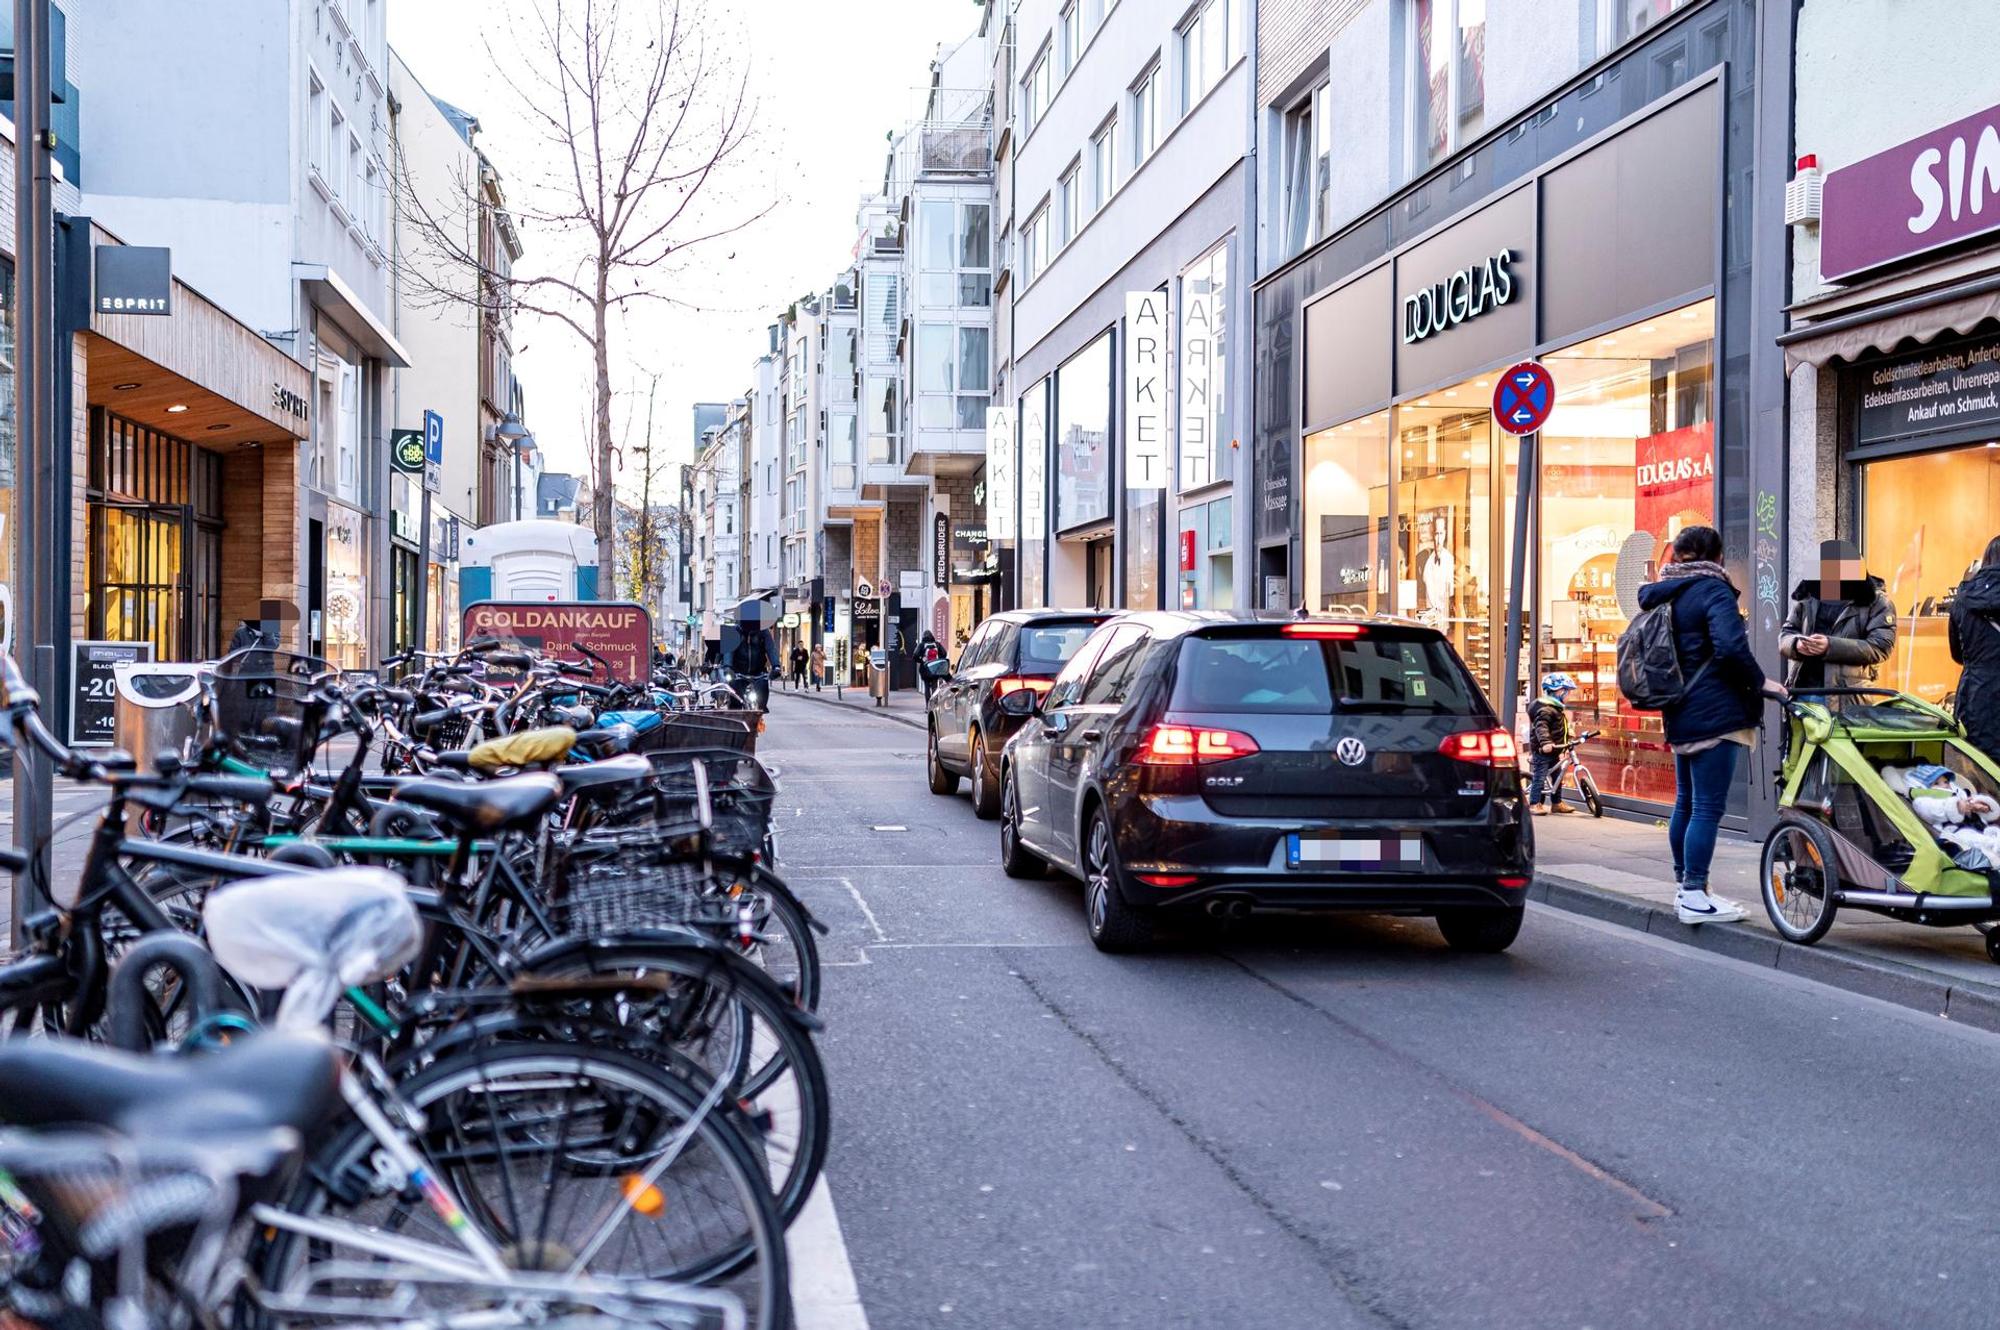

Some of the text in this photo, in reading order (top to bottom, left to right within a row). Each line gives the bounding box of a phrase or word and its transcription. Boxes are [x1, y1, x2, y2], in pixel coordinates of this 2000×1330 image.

[102, 297, 166, 310] ESPRIT
[1404, 248, 1511, 345] DOUGLAS
[1872, 354, 1966, 385] Goldschmiedearbeiten,
[272, 383, 308, 421] ESPRIT
[1136, 298, 1158, 481] ARKET
[1864, 380, 1951, 409] Edelsteinfassarbeiten,
[1907, 391, 1999, 422] Ankauf von Schmuck,
[430, 417, 440, 455] P
[993, 411, 1008, 534] ARKET
[1637, 457, 1692, 487] DOUGLAS
[1264, 494, 1287, 511] Massage
[475, 611, 637, 629] GOLDANKAUF
[547, 641, 637, 652] Dani Schmuck
[612, 660, 623, 669] 29
[1206, 776, 1244, 786] GOLF
